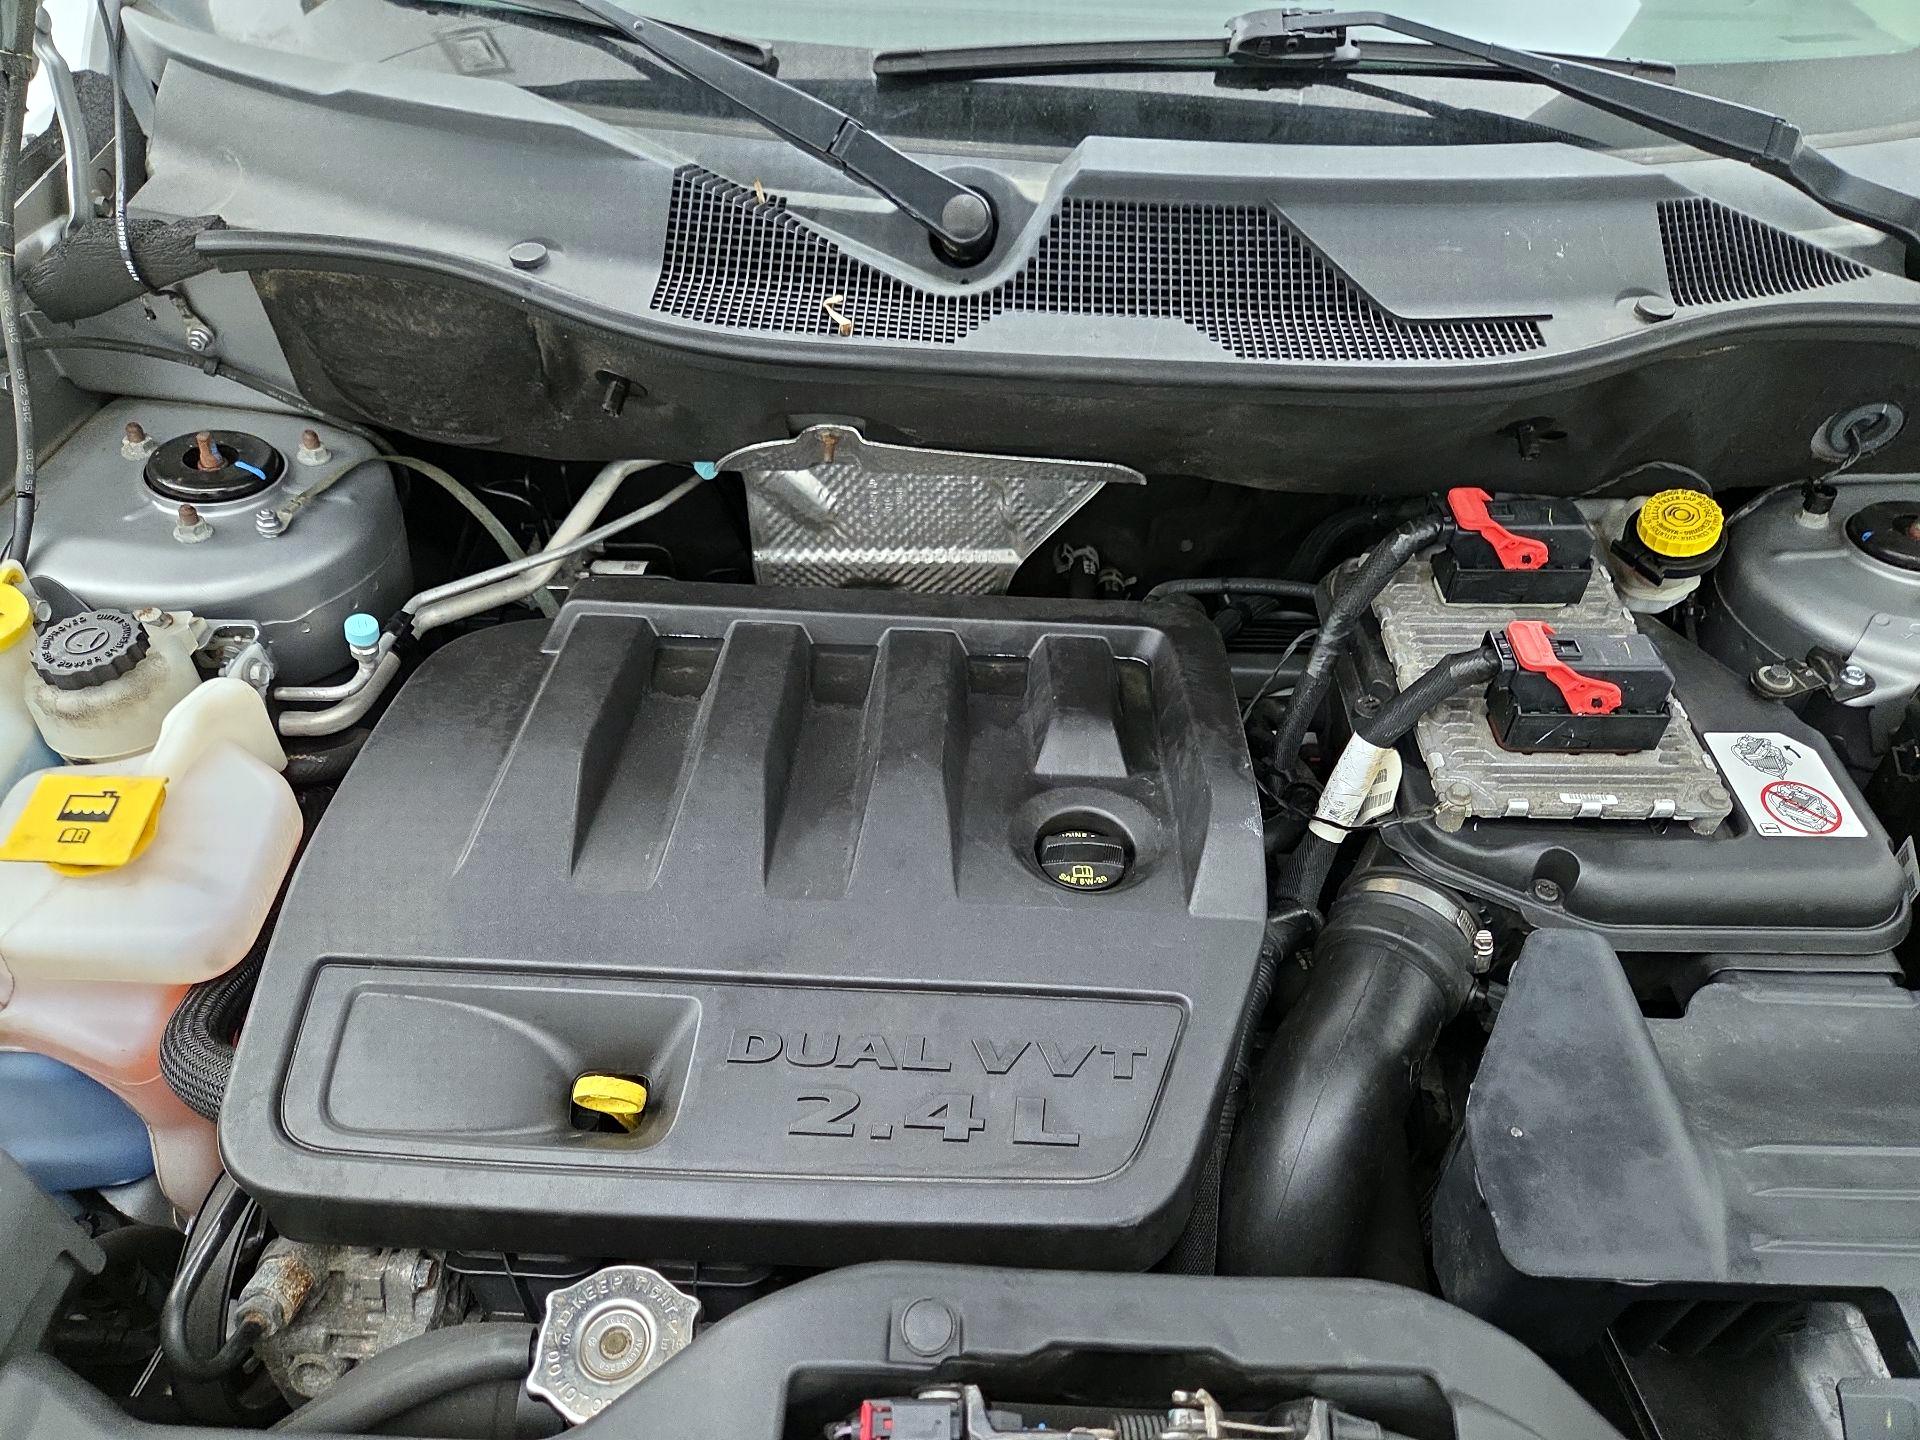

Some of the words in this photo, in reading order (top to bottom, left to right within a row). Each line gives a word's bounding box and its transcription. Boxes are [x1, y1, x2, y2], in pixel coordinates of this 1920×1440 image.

[57, 656, 102, 669] POWER
[1058, 873, 1077, 884] SAE
[727, 1029, 951, 1072] DUAL
[972, 1039, 1148, 1080] VVT
[571, 1275, 623, 1309] KEEP
[636, 1274, 679, 1314] TIGHT
